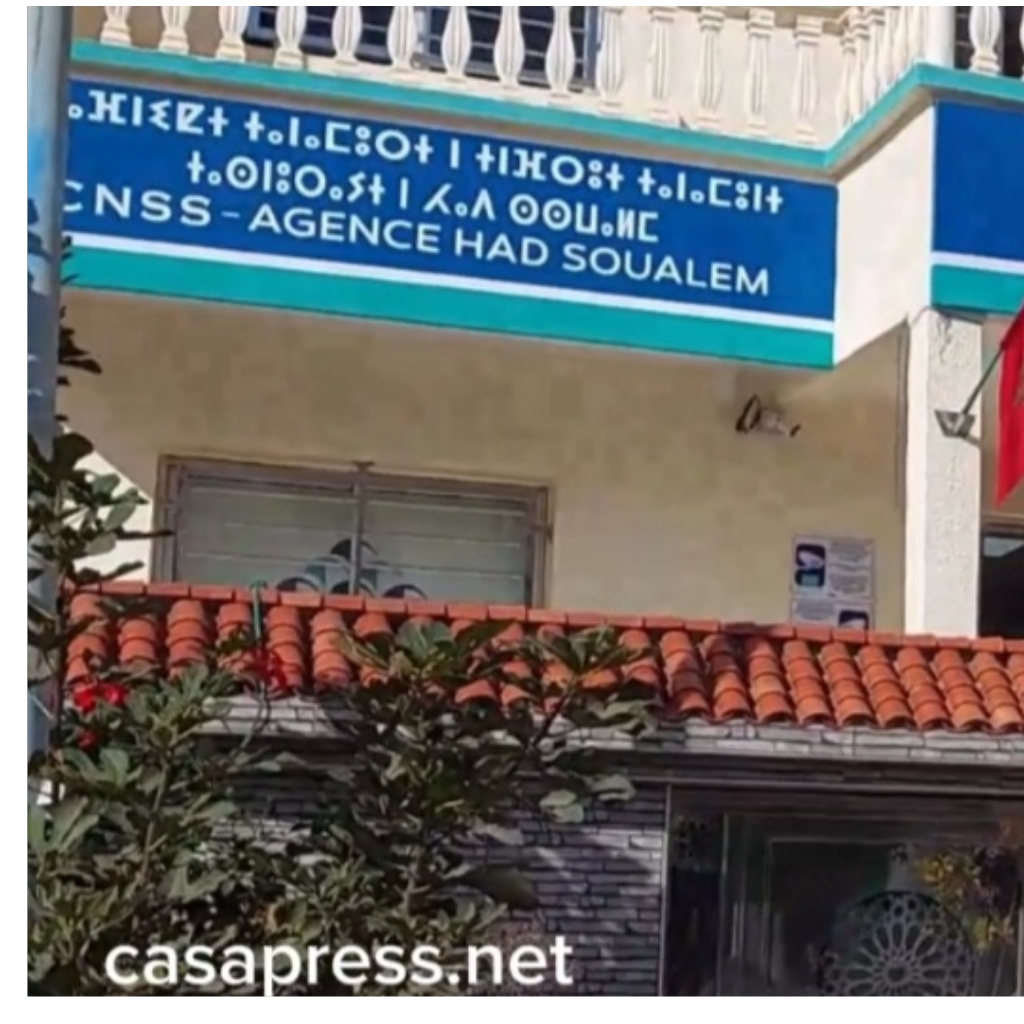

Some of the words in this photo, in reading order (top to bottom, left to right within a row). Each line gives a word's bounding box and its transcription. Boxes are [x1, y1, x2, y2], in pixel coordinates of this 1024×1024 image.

[63, 180, 212, 227] CNSS
[248, 203, 442, 255] AGENCE
[455, 228, 548, 267] HAD
[562, 243, 769, 296] SOUALEM
